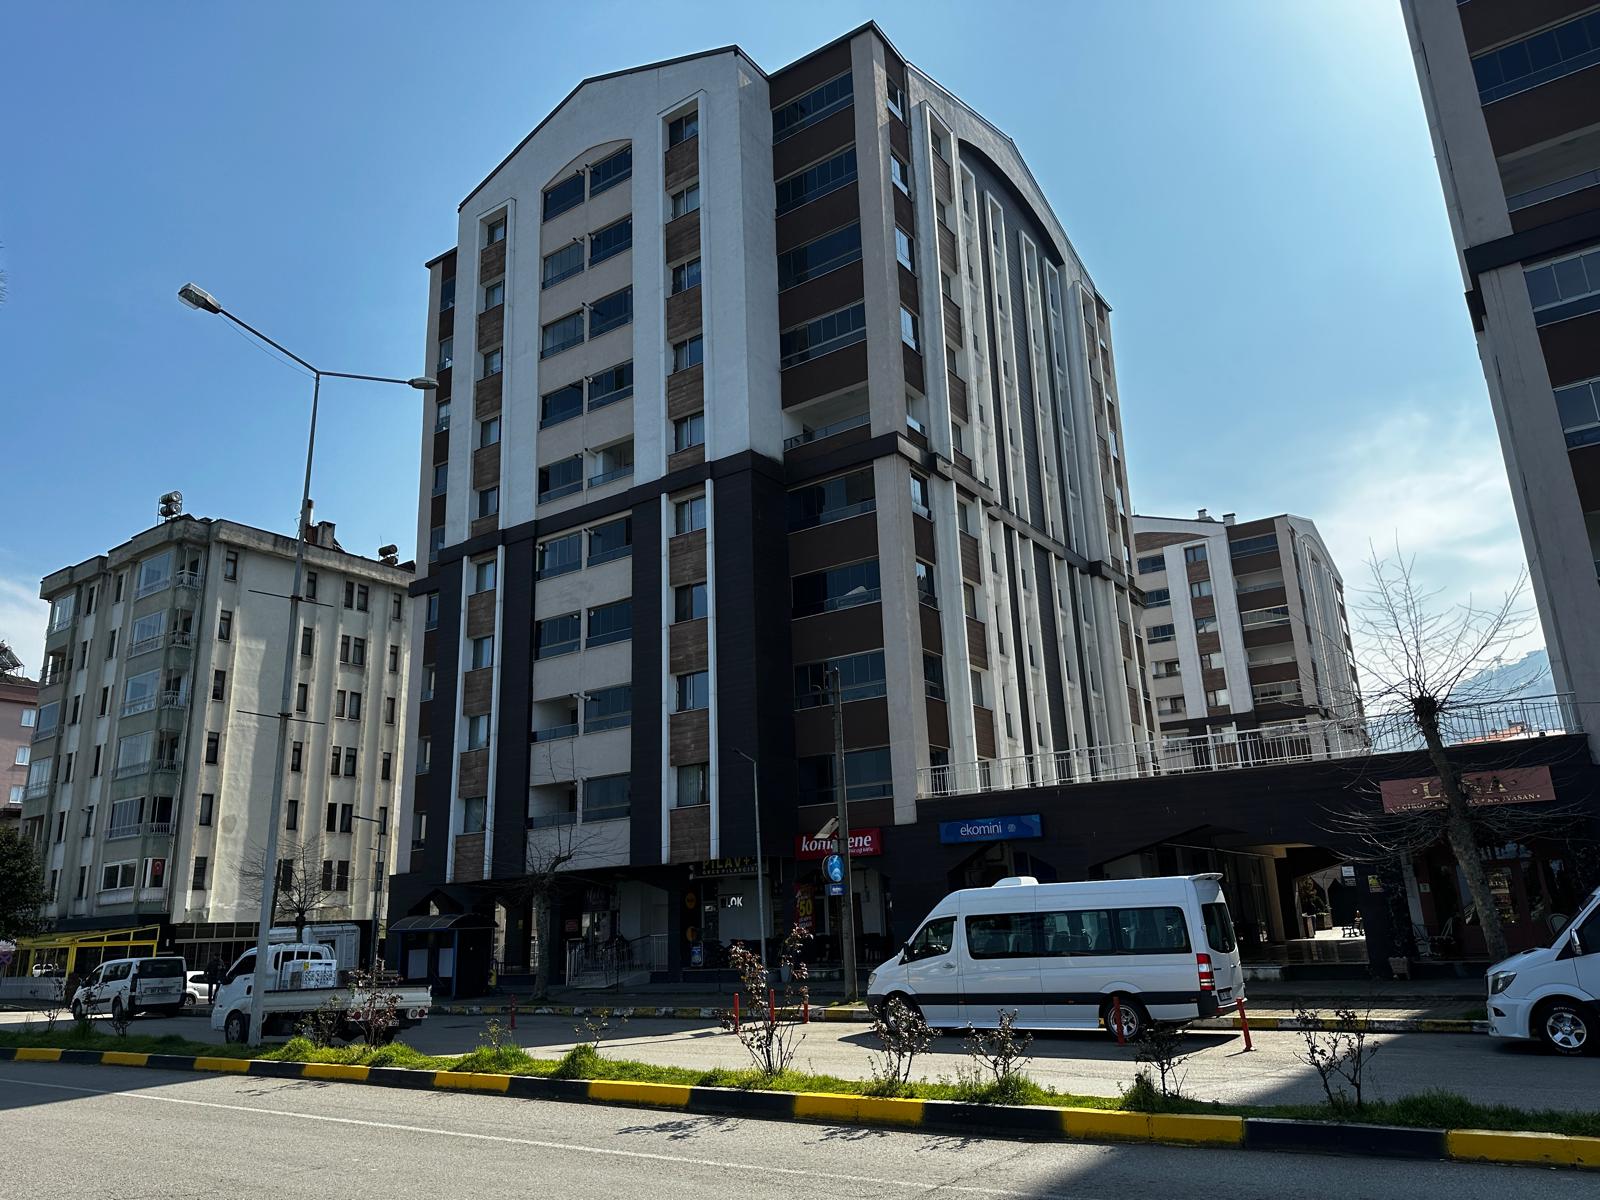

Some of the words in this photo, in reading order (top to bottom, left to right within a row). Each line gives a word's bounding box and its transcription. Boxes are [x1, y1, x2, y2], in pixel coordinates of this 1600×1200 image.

[960, 821, 1002, 836] ekomini
[801, 835, 872, 852] komene
[799, 898, 813, 917] 50
